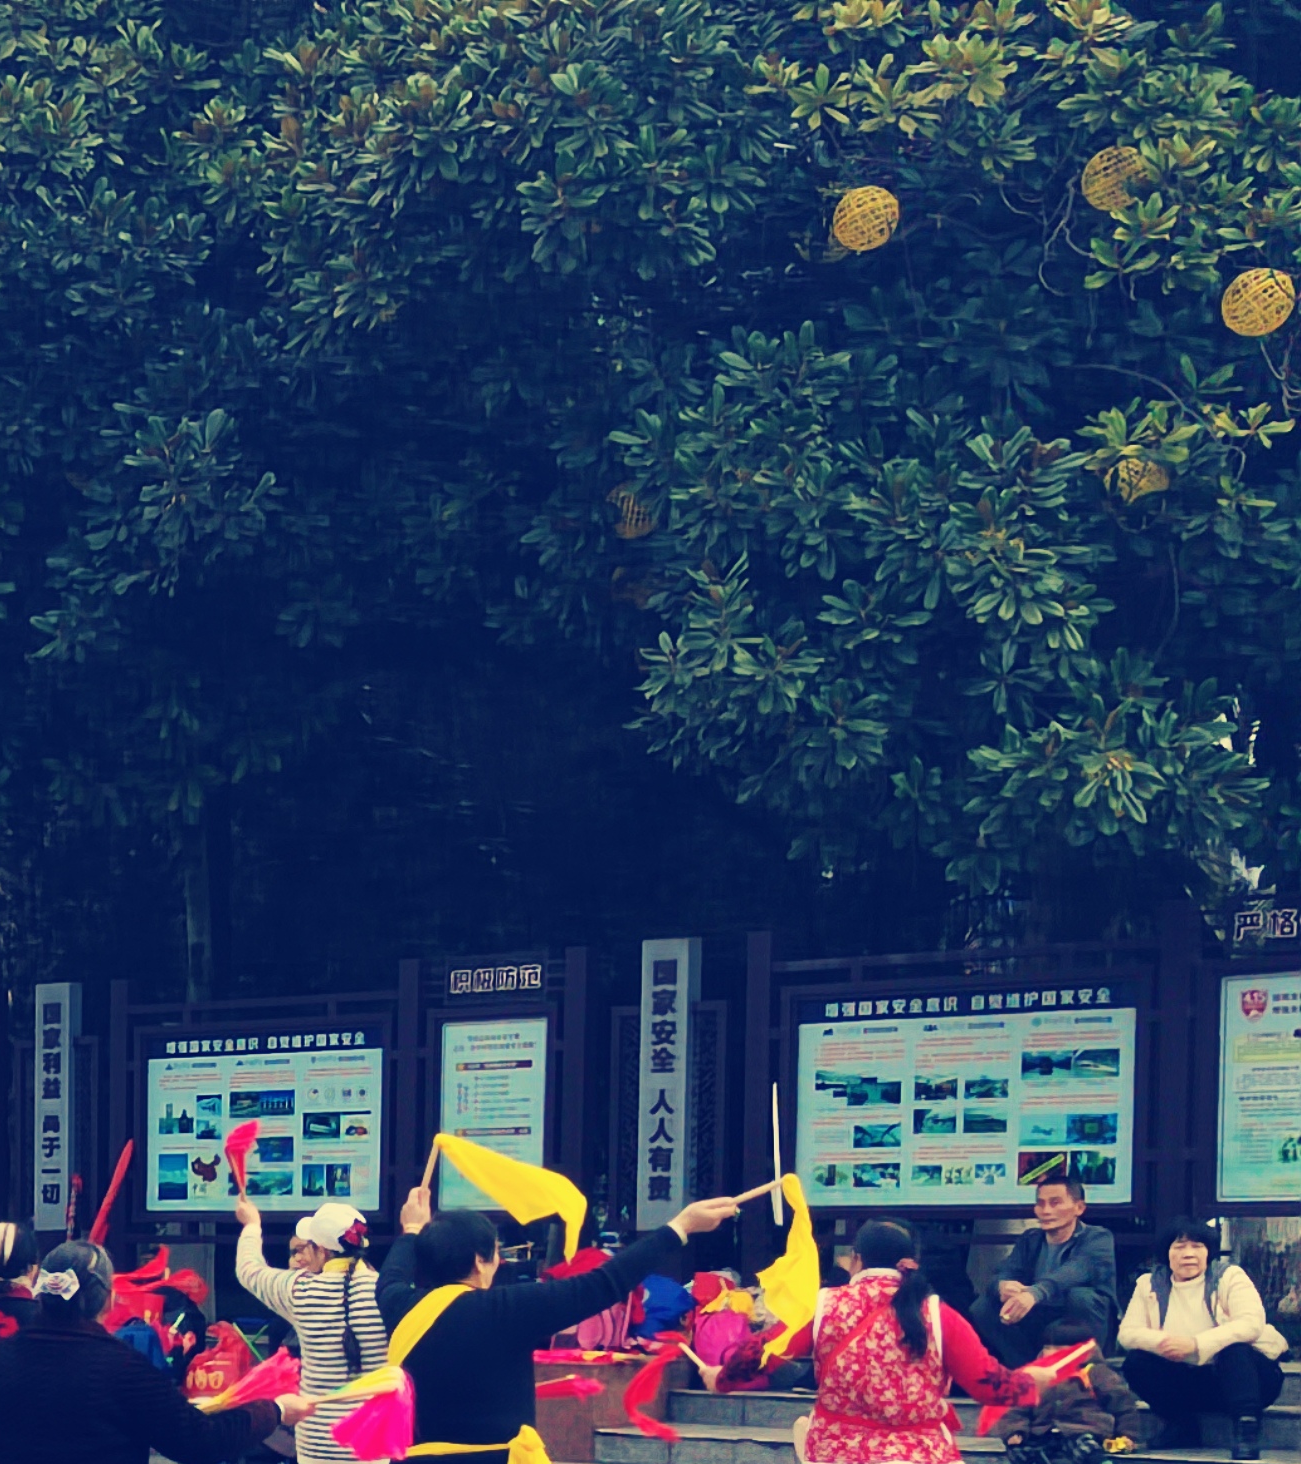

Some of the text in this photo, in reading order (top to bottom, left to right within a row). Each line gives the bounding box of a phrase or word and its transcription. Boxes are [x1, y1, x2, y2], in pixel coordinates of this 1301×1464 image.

[1233, 909, 1301, 942] 严格
[450, 964, 542, 994] 积极防范
[825, 988, 1111, 1018] 增强国家安全意识 自觉维护国家安全
[648, 959, 678, 1202] 国家安全 人人有责
[41, 1002, 62, 1205] 国家利益 高于一切
